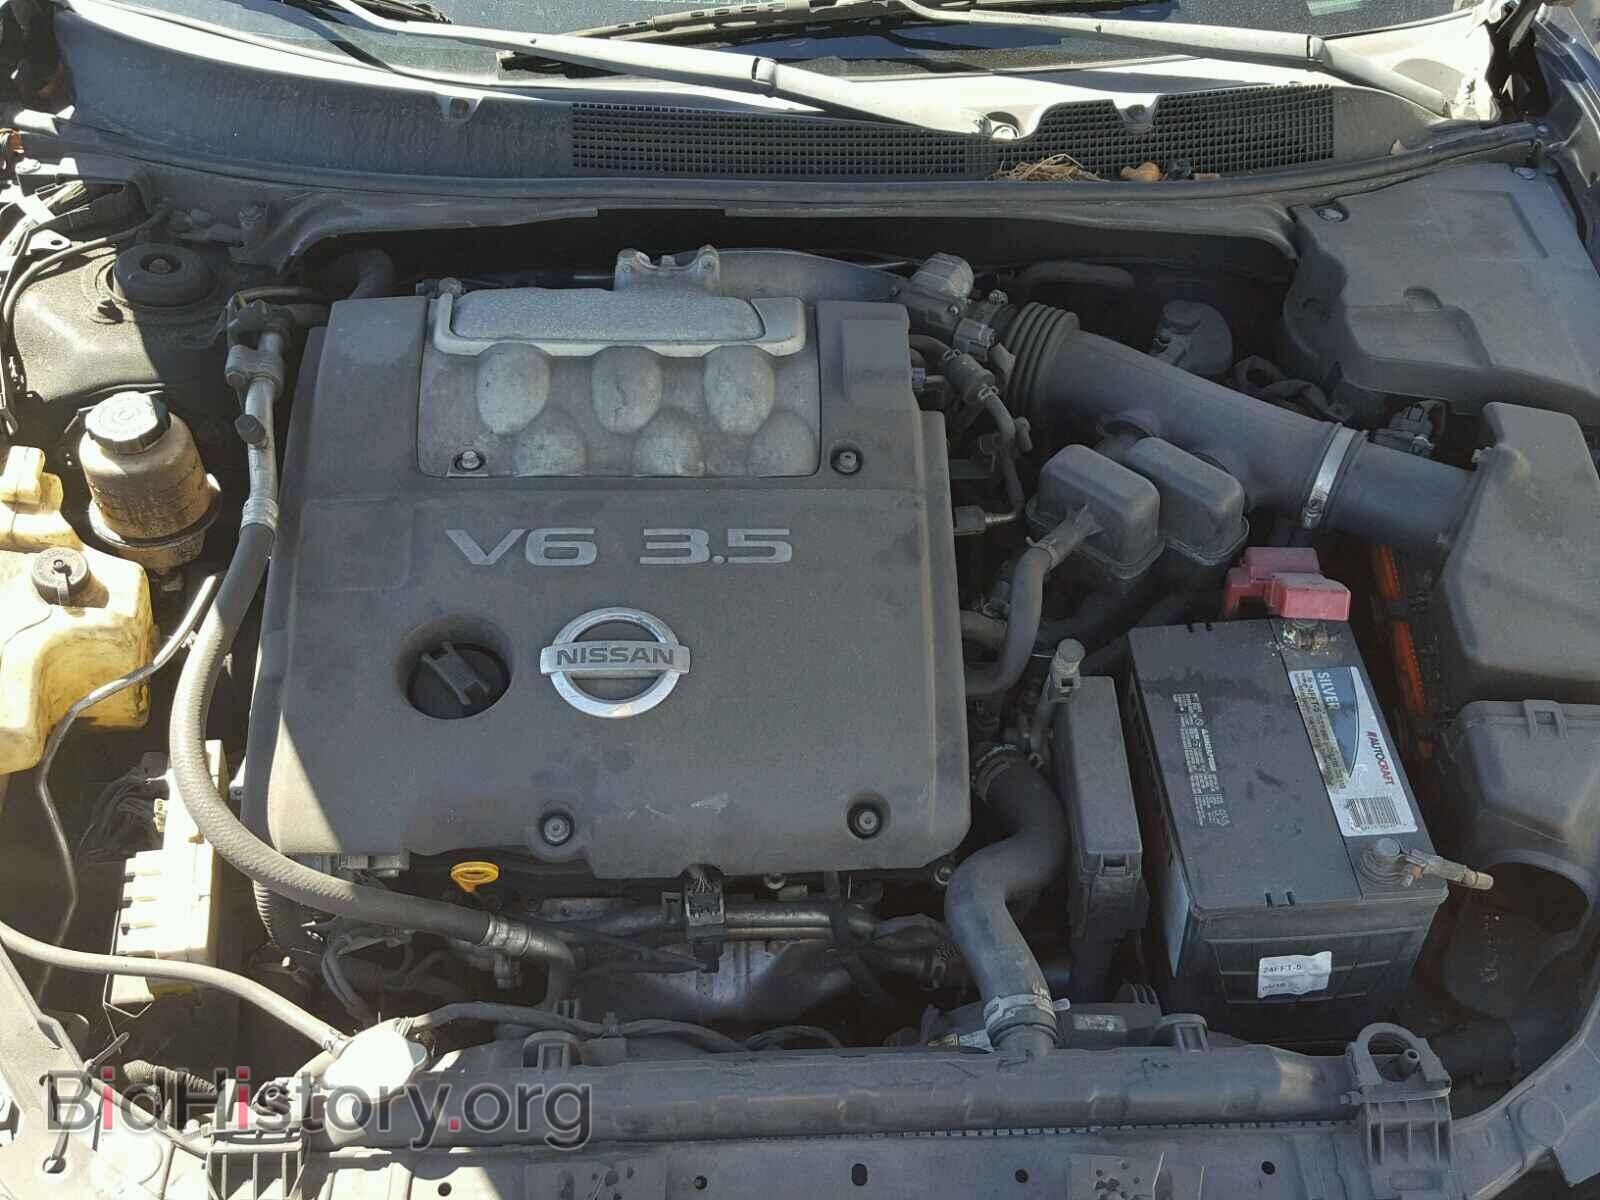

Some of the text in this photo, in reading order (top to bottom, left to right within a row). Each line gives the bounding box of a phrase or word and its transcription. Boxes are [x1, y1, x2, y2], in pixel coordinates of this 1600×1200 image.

[445, 527, 793, 567] V6 3.5
[555, 646, 675, 667] NISSAN
[1317, 671, 1341, 711] SILVER
[1367, 733, 1396, 786] AUTOCRAFT
